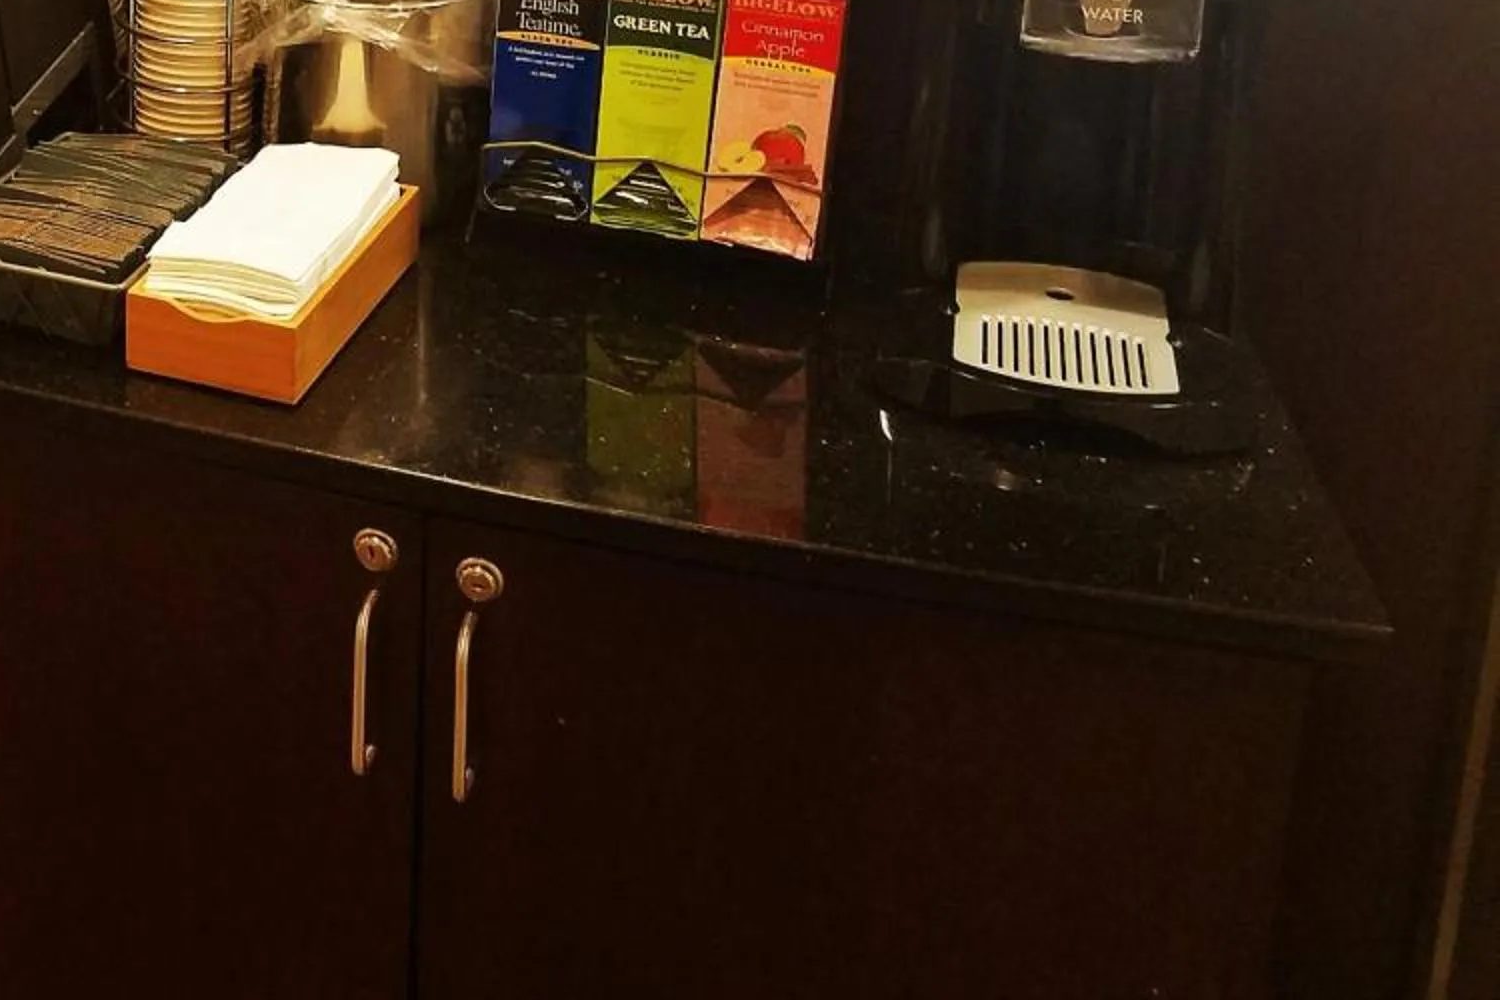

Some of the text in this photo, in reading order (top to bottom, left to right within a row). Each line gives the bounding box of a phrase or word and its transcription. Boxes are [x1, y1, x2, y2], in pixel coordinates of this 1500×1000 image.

[516, 11, 580, 36] Teatime
[1081, 4, 1144, 25] WATER
[613, 14, 711, 41] GREEN TEA
[741, 20, 825, 43] Cinnamon
[756, 34, 805, 60] Apple
